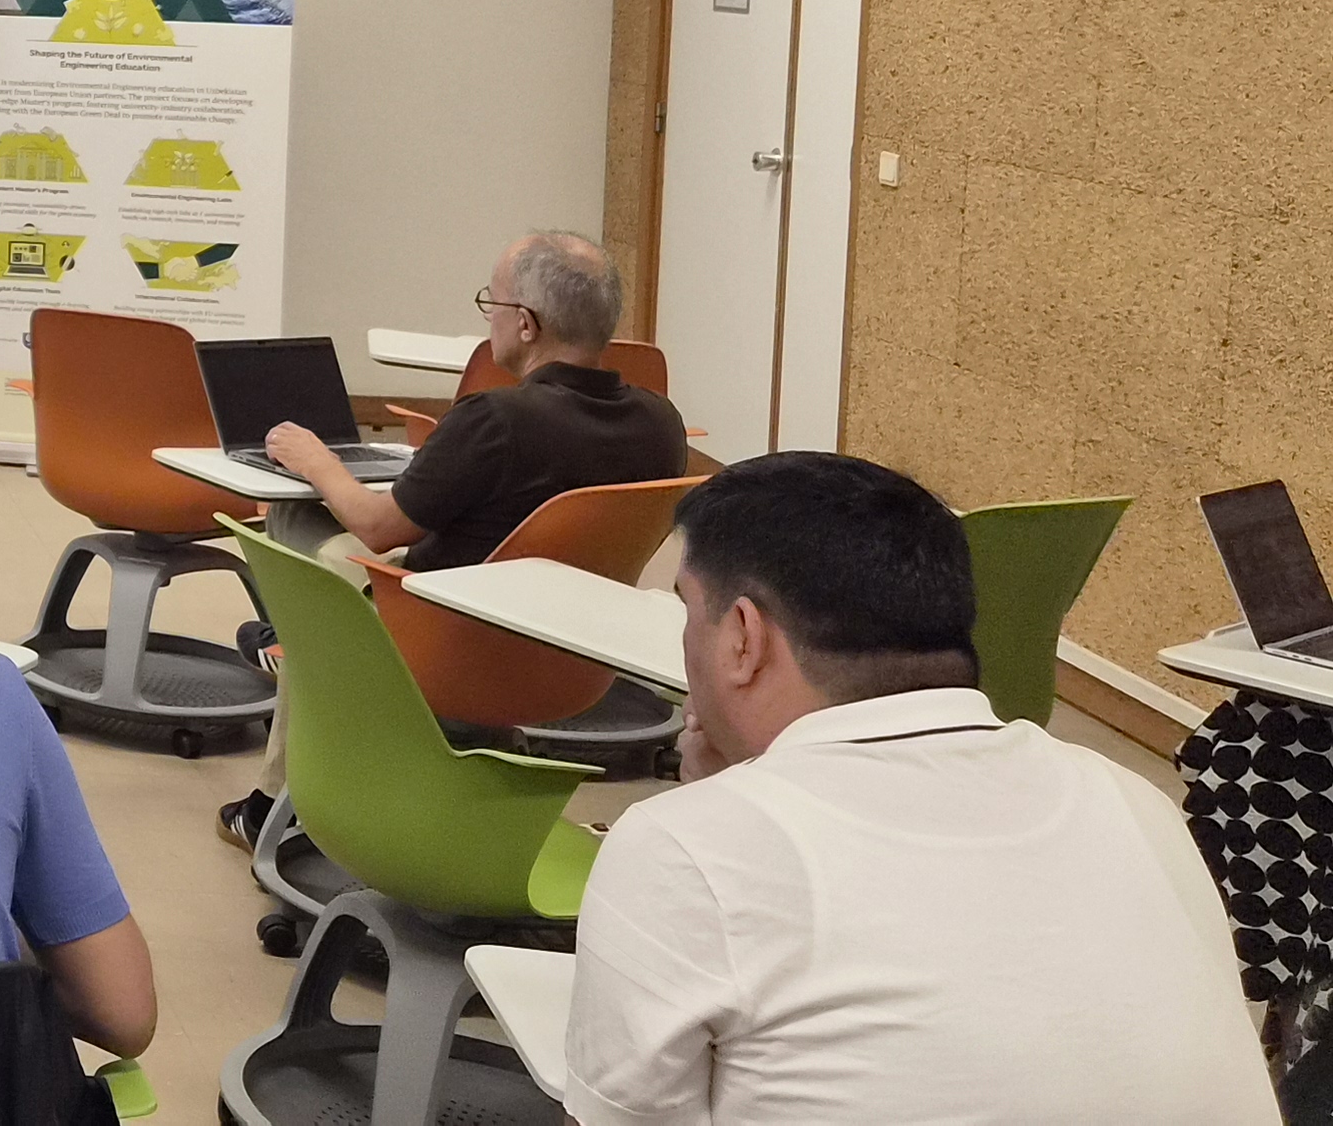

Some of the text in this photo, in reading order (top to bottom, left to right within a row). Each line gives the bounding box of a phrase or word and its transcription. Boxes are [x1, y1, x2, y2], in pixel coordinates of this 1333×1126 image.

[29, 49, 193, 62] Shaping the Future of Environmental
[60, 61, 161, 72] Engineering Education
[56, 81, 110, 90] Environmental
[69, 90, 92, 98] Union
[128, 93, 142, 101] The
